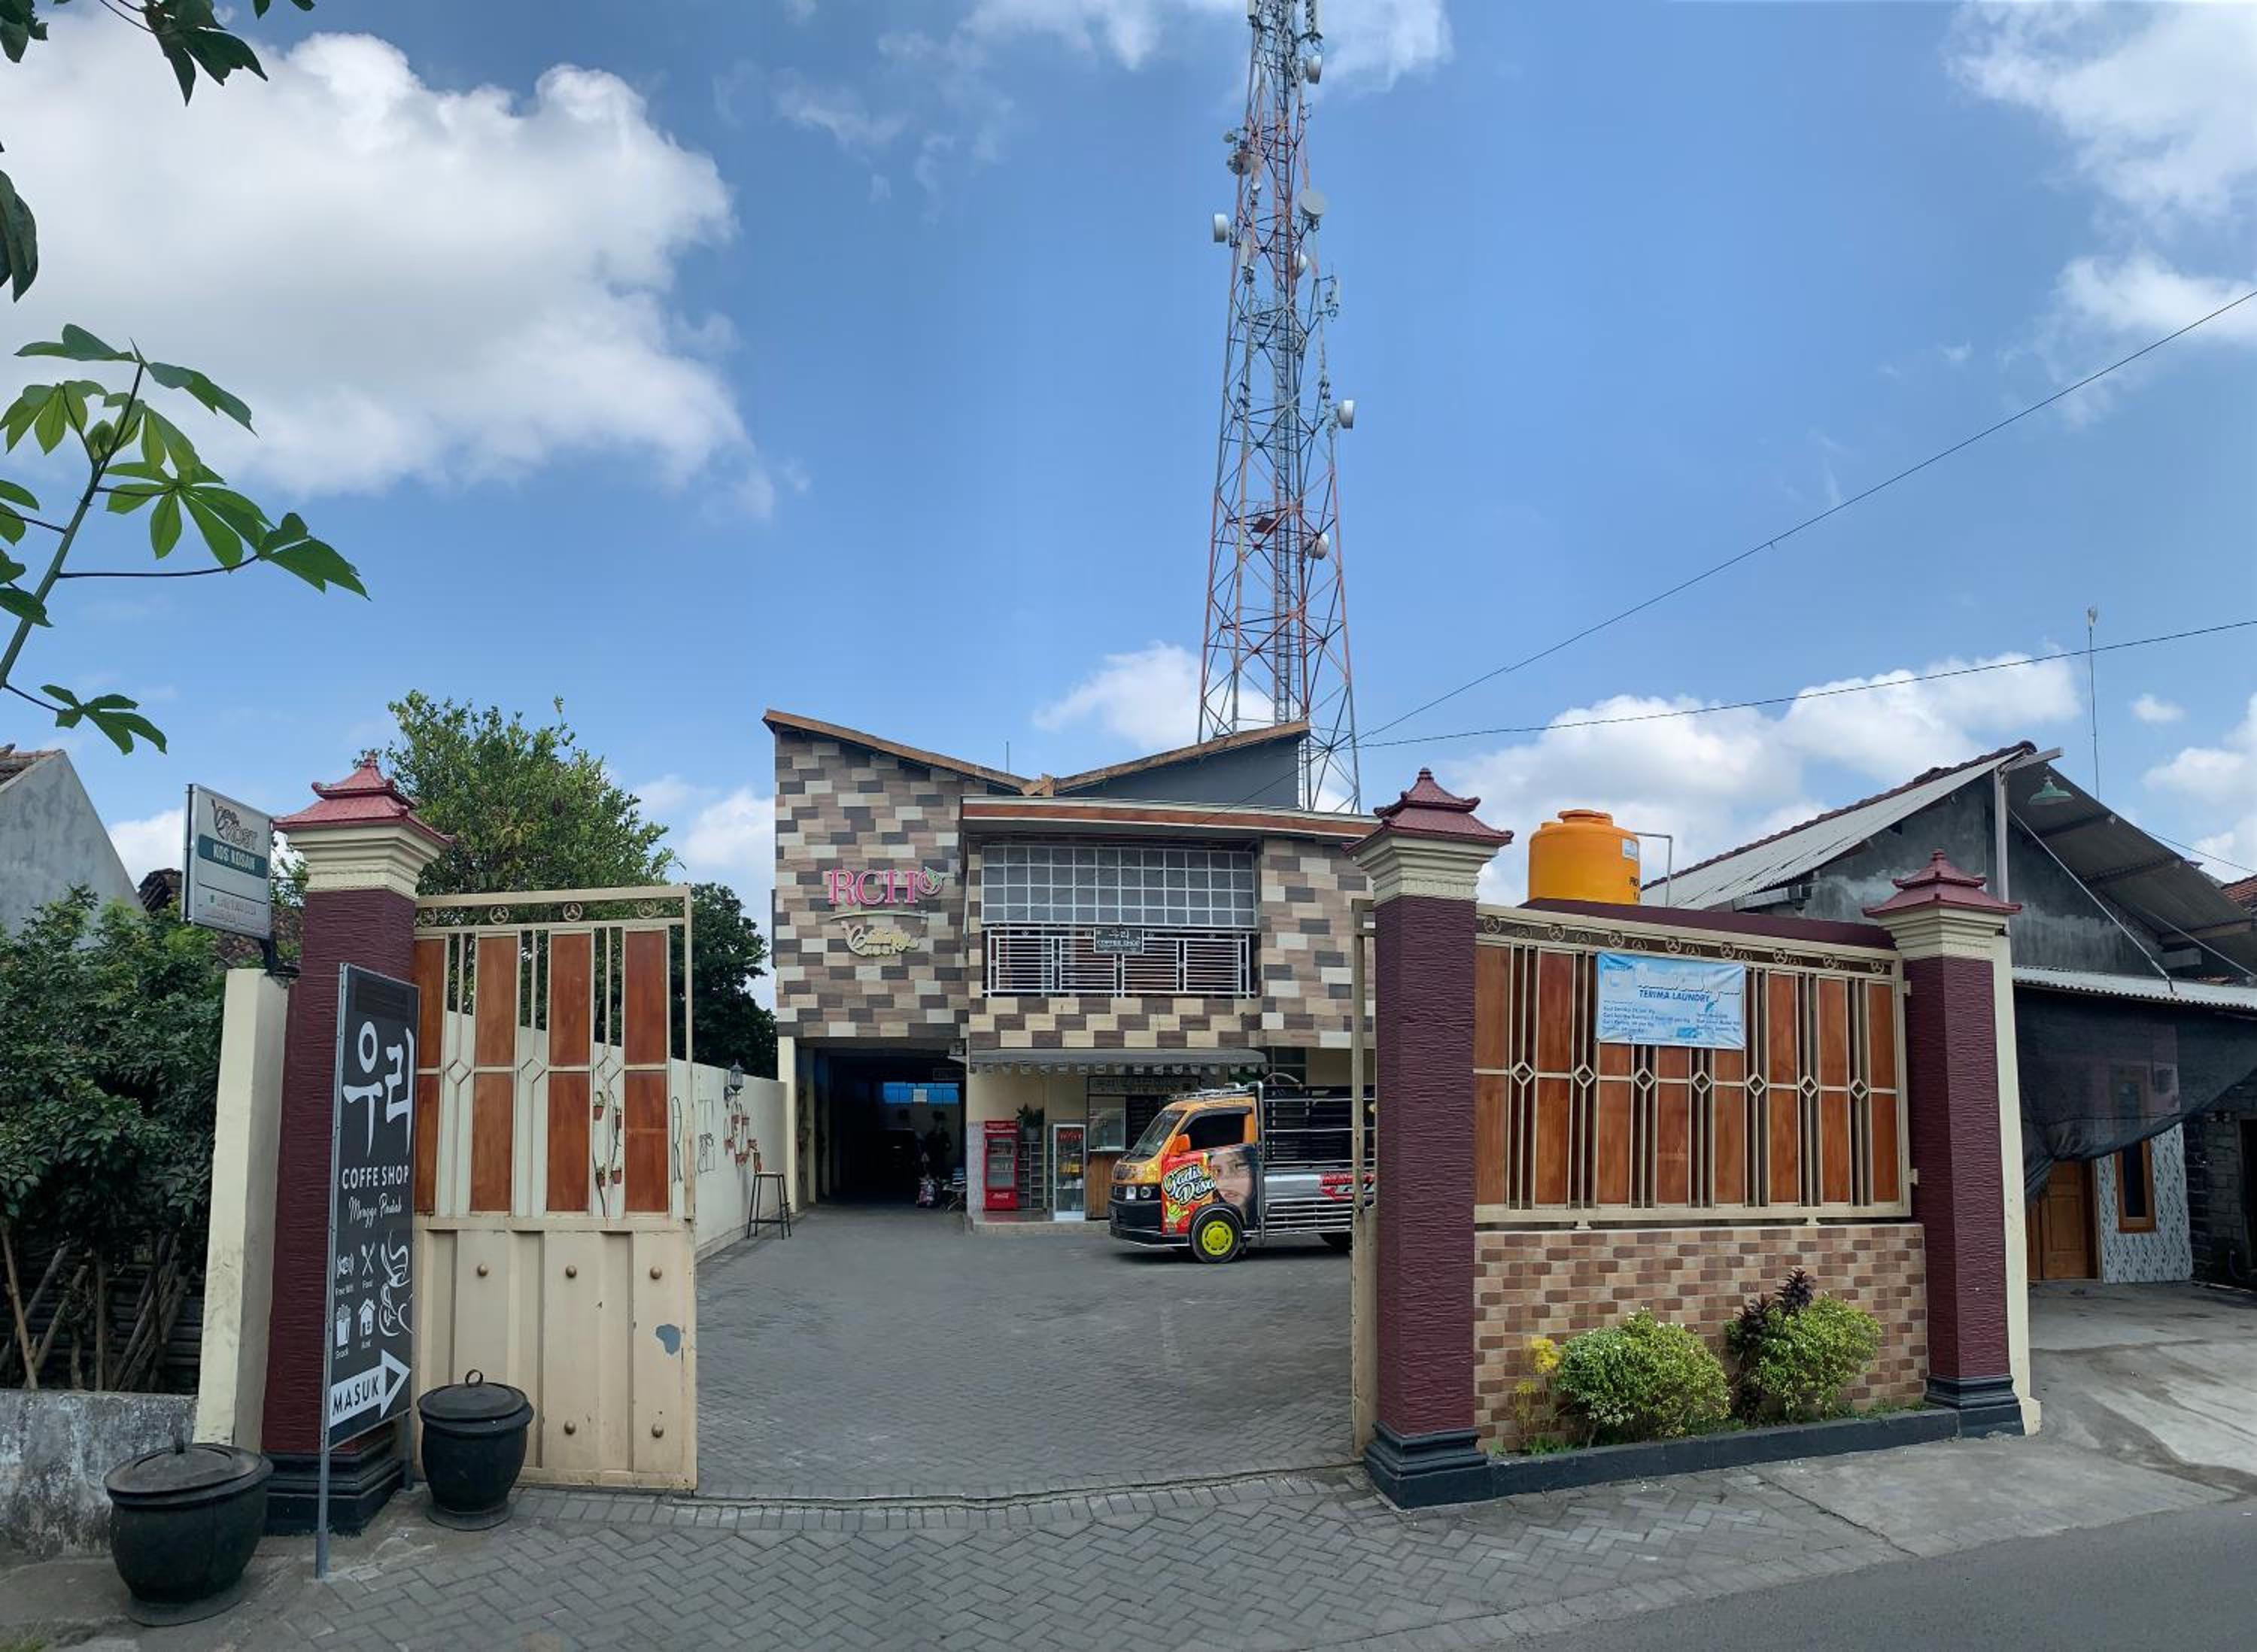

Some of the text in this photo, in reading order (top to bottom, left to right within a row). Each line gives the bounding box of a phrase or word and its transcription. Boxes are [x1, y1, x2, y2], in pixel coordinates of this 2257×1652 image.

[827, 867, 918, 906] RCH
[1639, 988, 1710, 1003] TERIMA LAUNDRY
[343, 1021, 414, 1159] 우리
[342, 1165, 409, 1190] COFFE SHOP
[332, 1375, 380, 1416] MASUK
